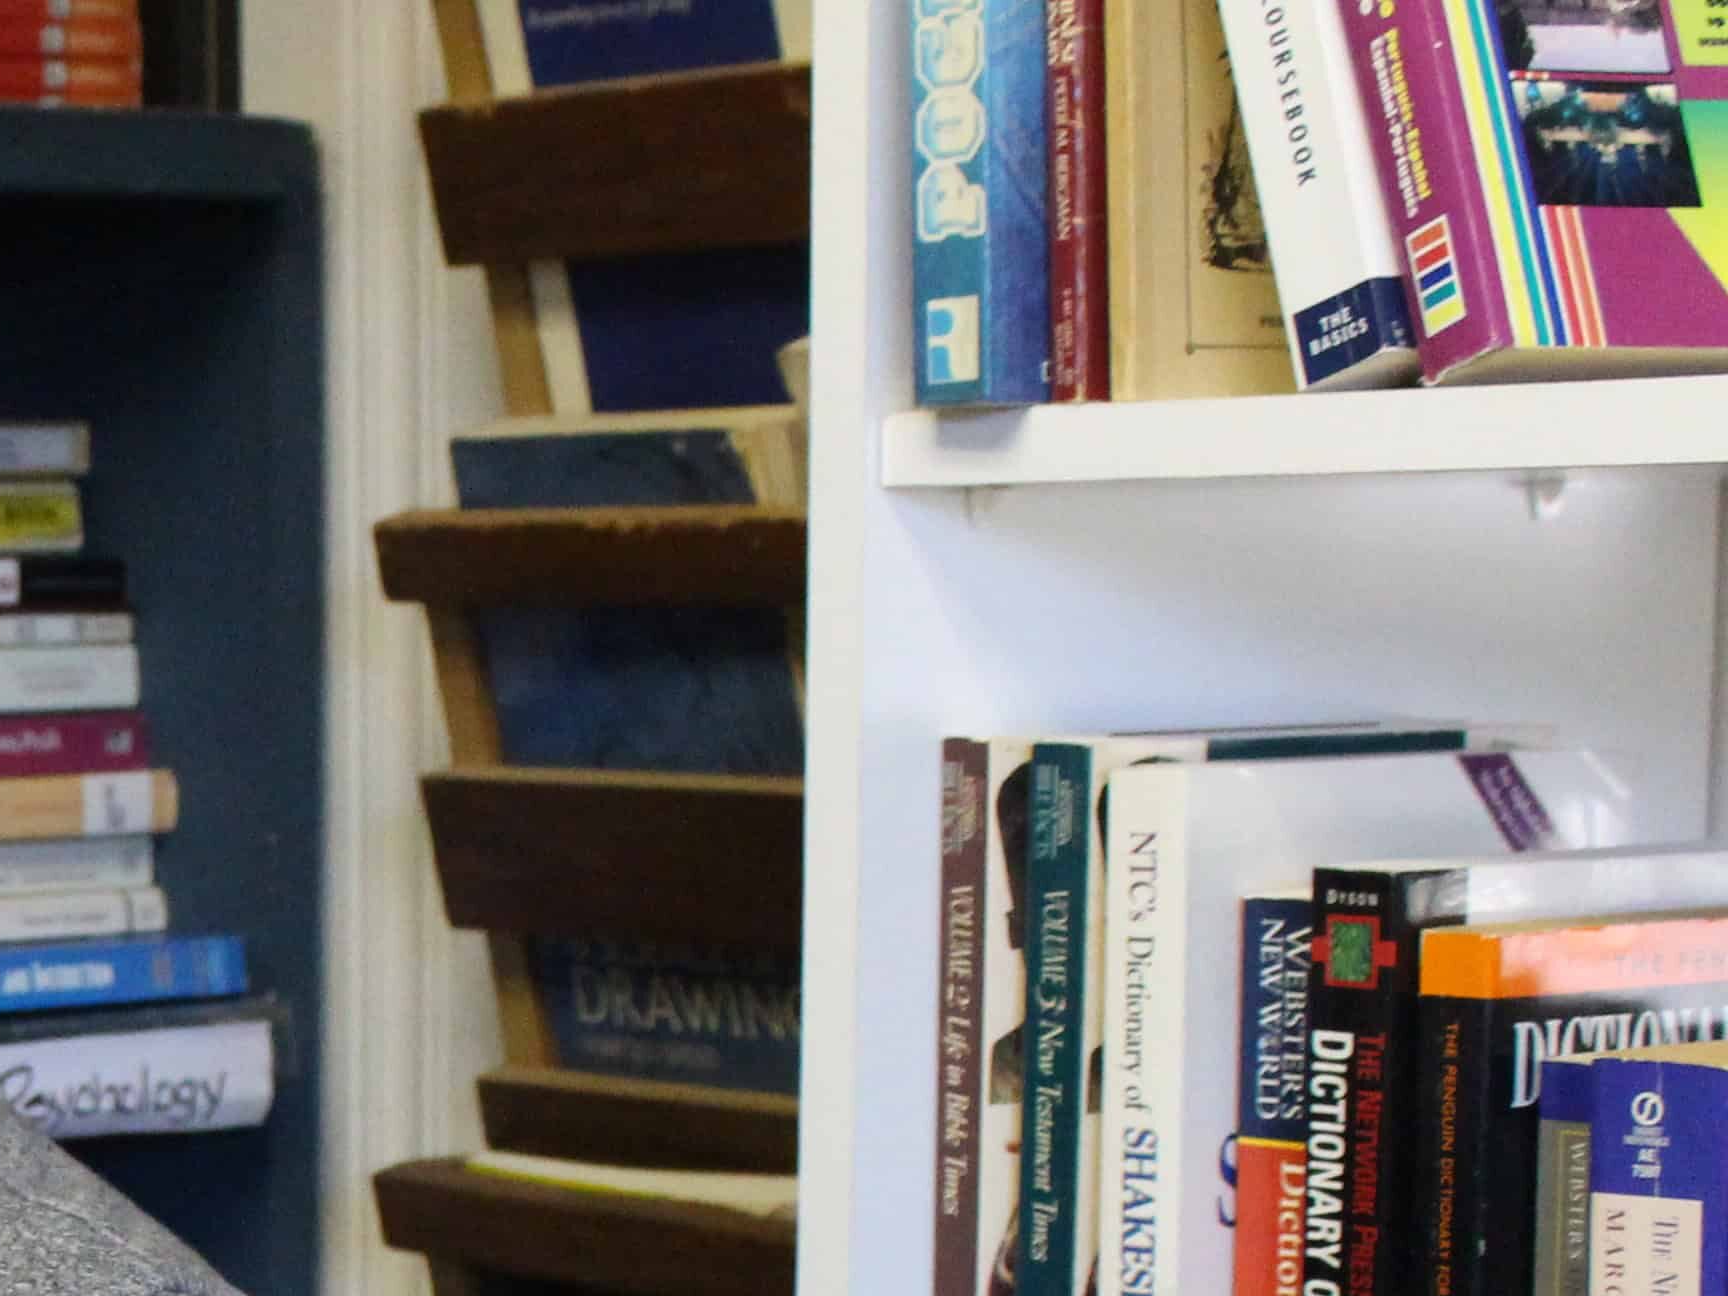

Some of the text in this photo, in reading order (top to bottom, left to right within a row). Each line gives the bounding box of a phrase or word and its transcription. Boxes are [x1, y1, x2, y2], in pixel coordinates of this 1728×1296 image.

[1308, 319, 1369, 357] BASICS
[1318, 305, 1352, 331] THE
[1128, 832, 1160, 923] NTC's
[1040, 889, 1071, 985] VOLUME
[1119, 935, 1157, 1076] Dictionary
[1281, 926, 1313, 1121] WEBSTER'S
[1445, 1022, 1459, 1057] THE
[1037, 1020, 1067, 1076] New
[1356, 1033, 1386, 1081] THE
[1124, 1084, 1154, 1111] of
[1440, 1064, 1459, 1149] PENGUIN
[1033, 1083, 1065, 1194] Testament
[1306, 1028, 1355, 1269] DICTIONARY
[1351, 1090, 1384, 1216] NETWORK
[1029, 1198, 1060, 1262] Times
[1436, 1157, 1455, 1258] DICTIONARY
[1650, 1215, 1679, 1260] THE
[1436, 1265, 1451, 1296] FOR
